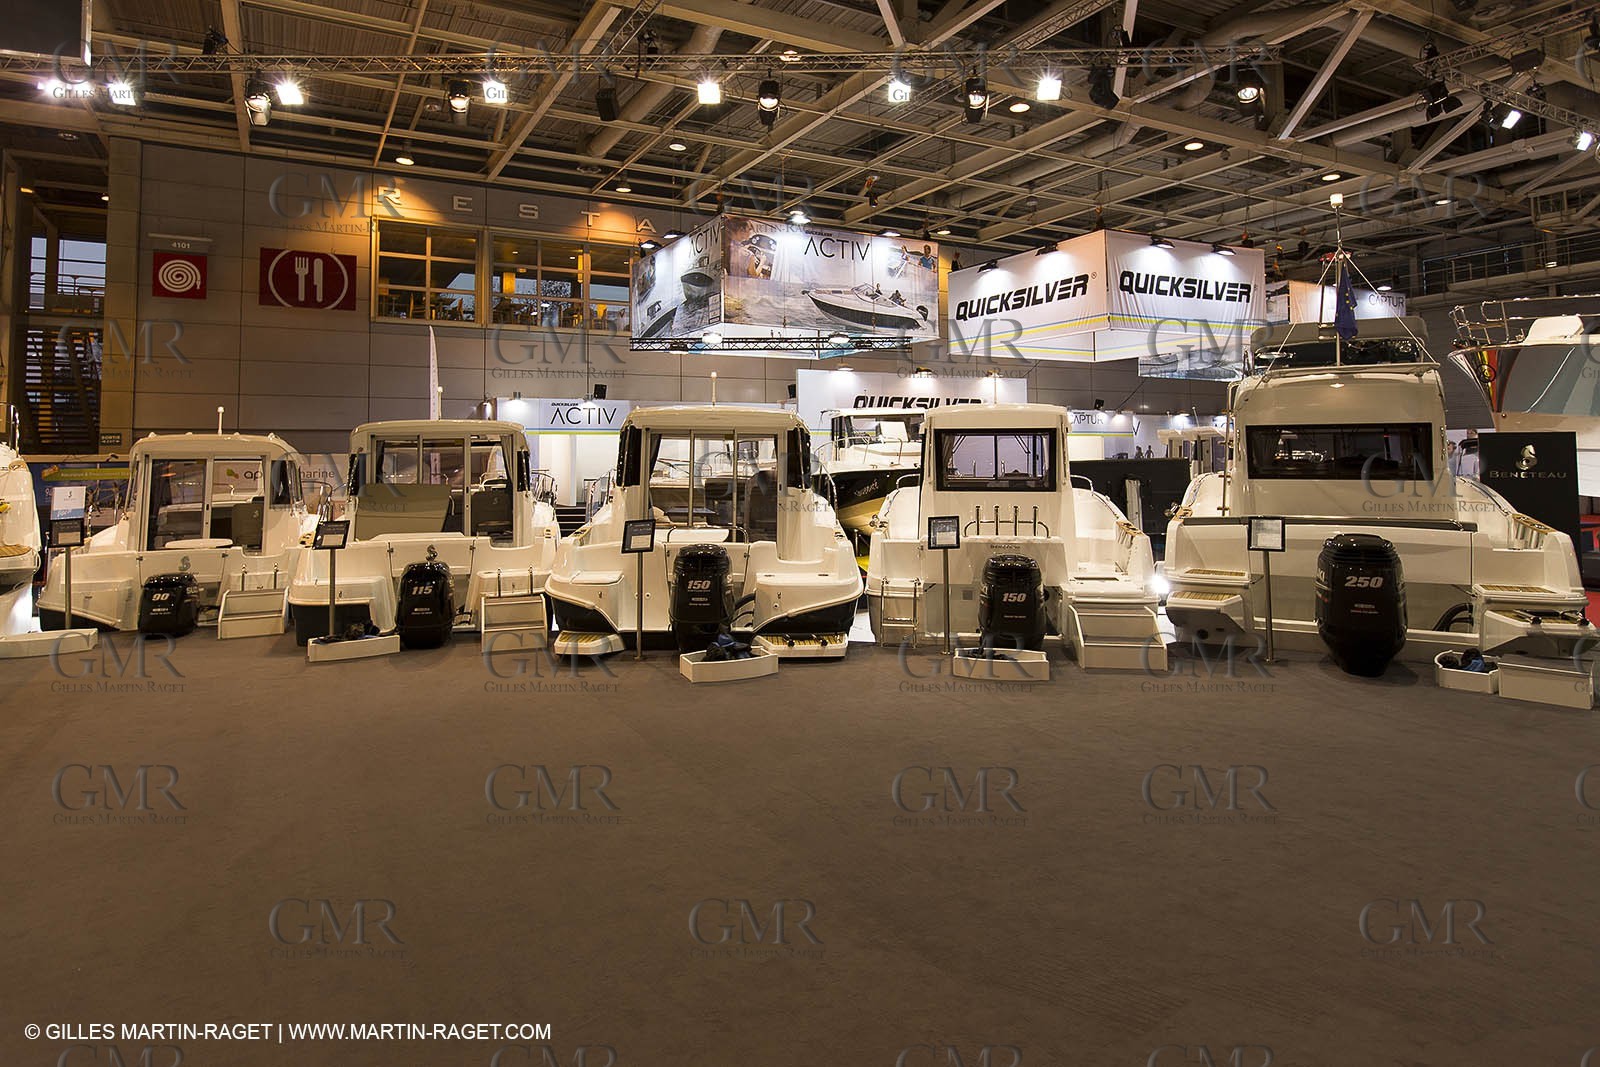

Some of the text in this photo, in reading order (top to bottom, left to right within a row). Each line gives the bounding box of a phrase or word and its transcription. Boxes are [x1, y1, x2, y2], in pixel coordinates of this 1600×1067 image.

[171, 241, 190, 249] 4101
[689, 221, 721, 257] ACTIV
[804, 236, 870, 261] ACTIV
[1119, 270, 1251, 303] QUICKSILVER
[956, 273, 1089, 321] QUICKSILVER
[853, 395, 982, 409] QUICKSI
[550, 407, 617, 425] ACTIV
[1072, 414, 1104, 425] APTUR
[687, 579, 711, 590] 150
[1344, 575, 1384, 589] 250
[151, 593, 171, 602] 90
[411, 585, 433, 596] 115
[1002, 592, 1027, 603] 150
